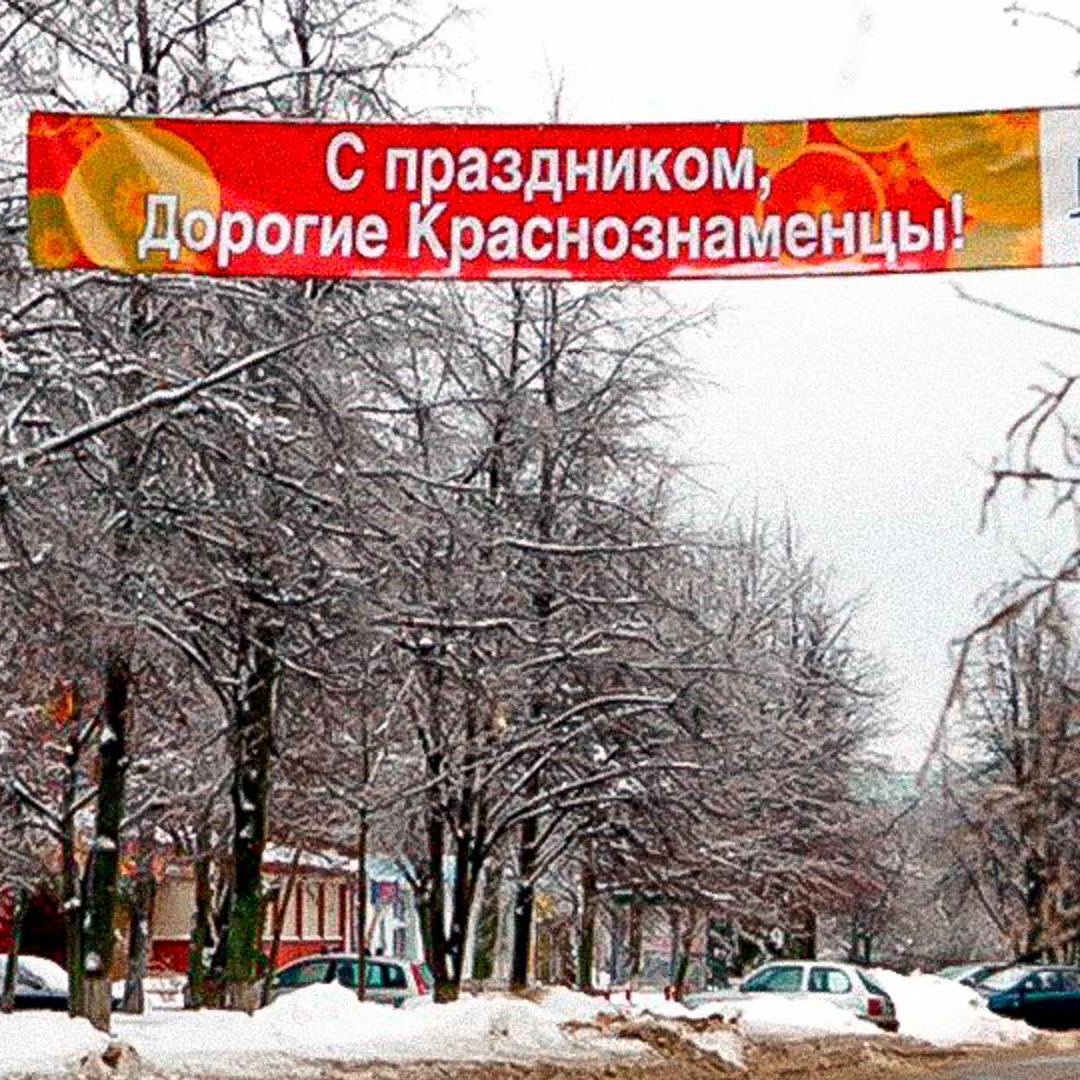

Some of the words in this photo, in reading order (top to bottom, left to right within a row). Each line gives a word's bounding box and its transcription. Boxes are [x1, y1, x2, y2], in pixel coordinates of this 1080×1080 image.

[325, 130, 366, 191] С
[384, 145, 772, 206] праздником,
[136, 193, 389, 267] Дорогие
[406, 192, 966, 274] Краснознаменцы!
